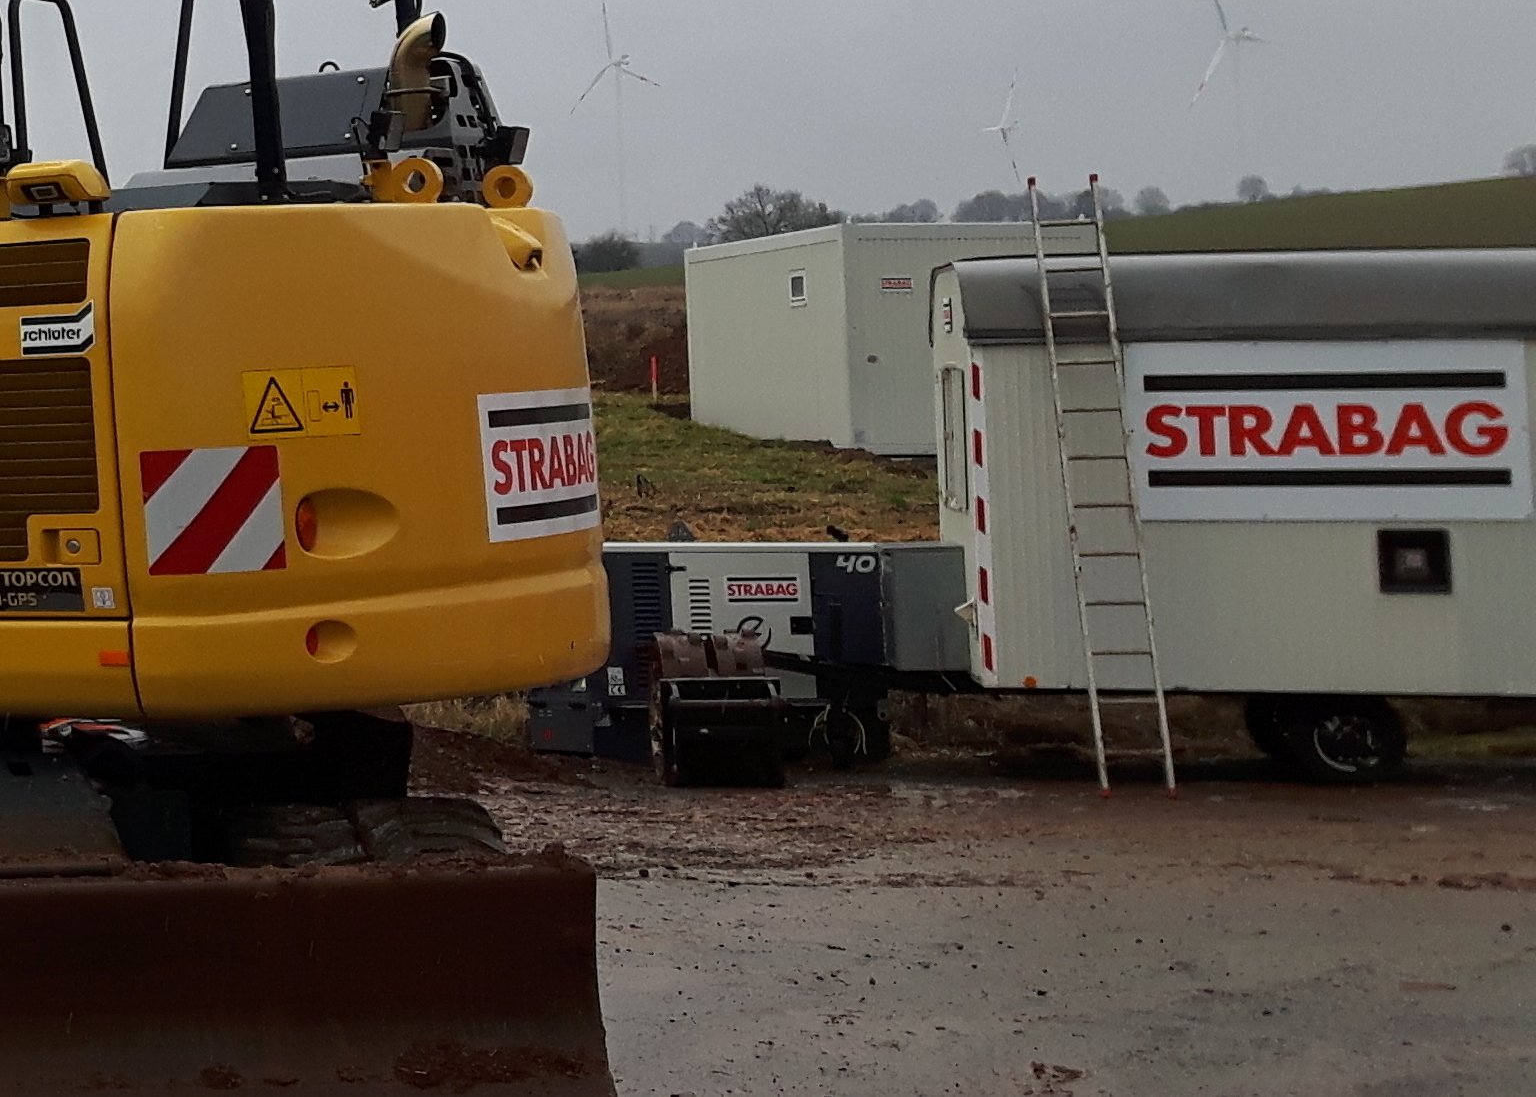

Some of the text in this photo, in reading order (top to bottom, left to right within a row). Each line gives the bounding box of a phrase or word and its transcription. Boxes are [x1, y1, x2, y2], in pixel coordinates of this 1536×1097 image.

[1144, 400, 1509, 458] STRABAG
[491, 429, 595, 496] STRABAG
[836, 554, 877, 574] 40
[0, 570, 77, 588] TOPCON
[727, 582, 798, 597] STRABAG
